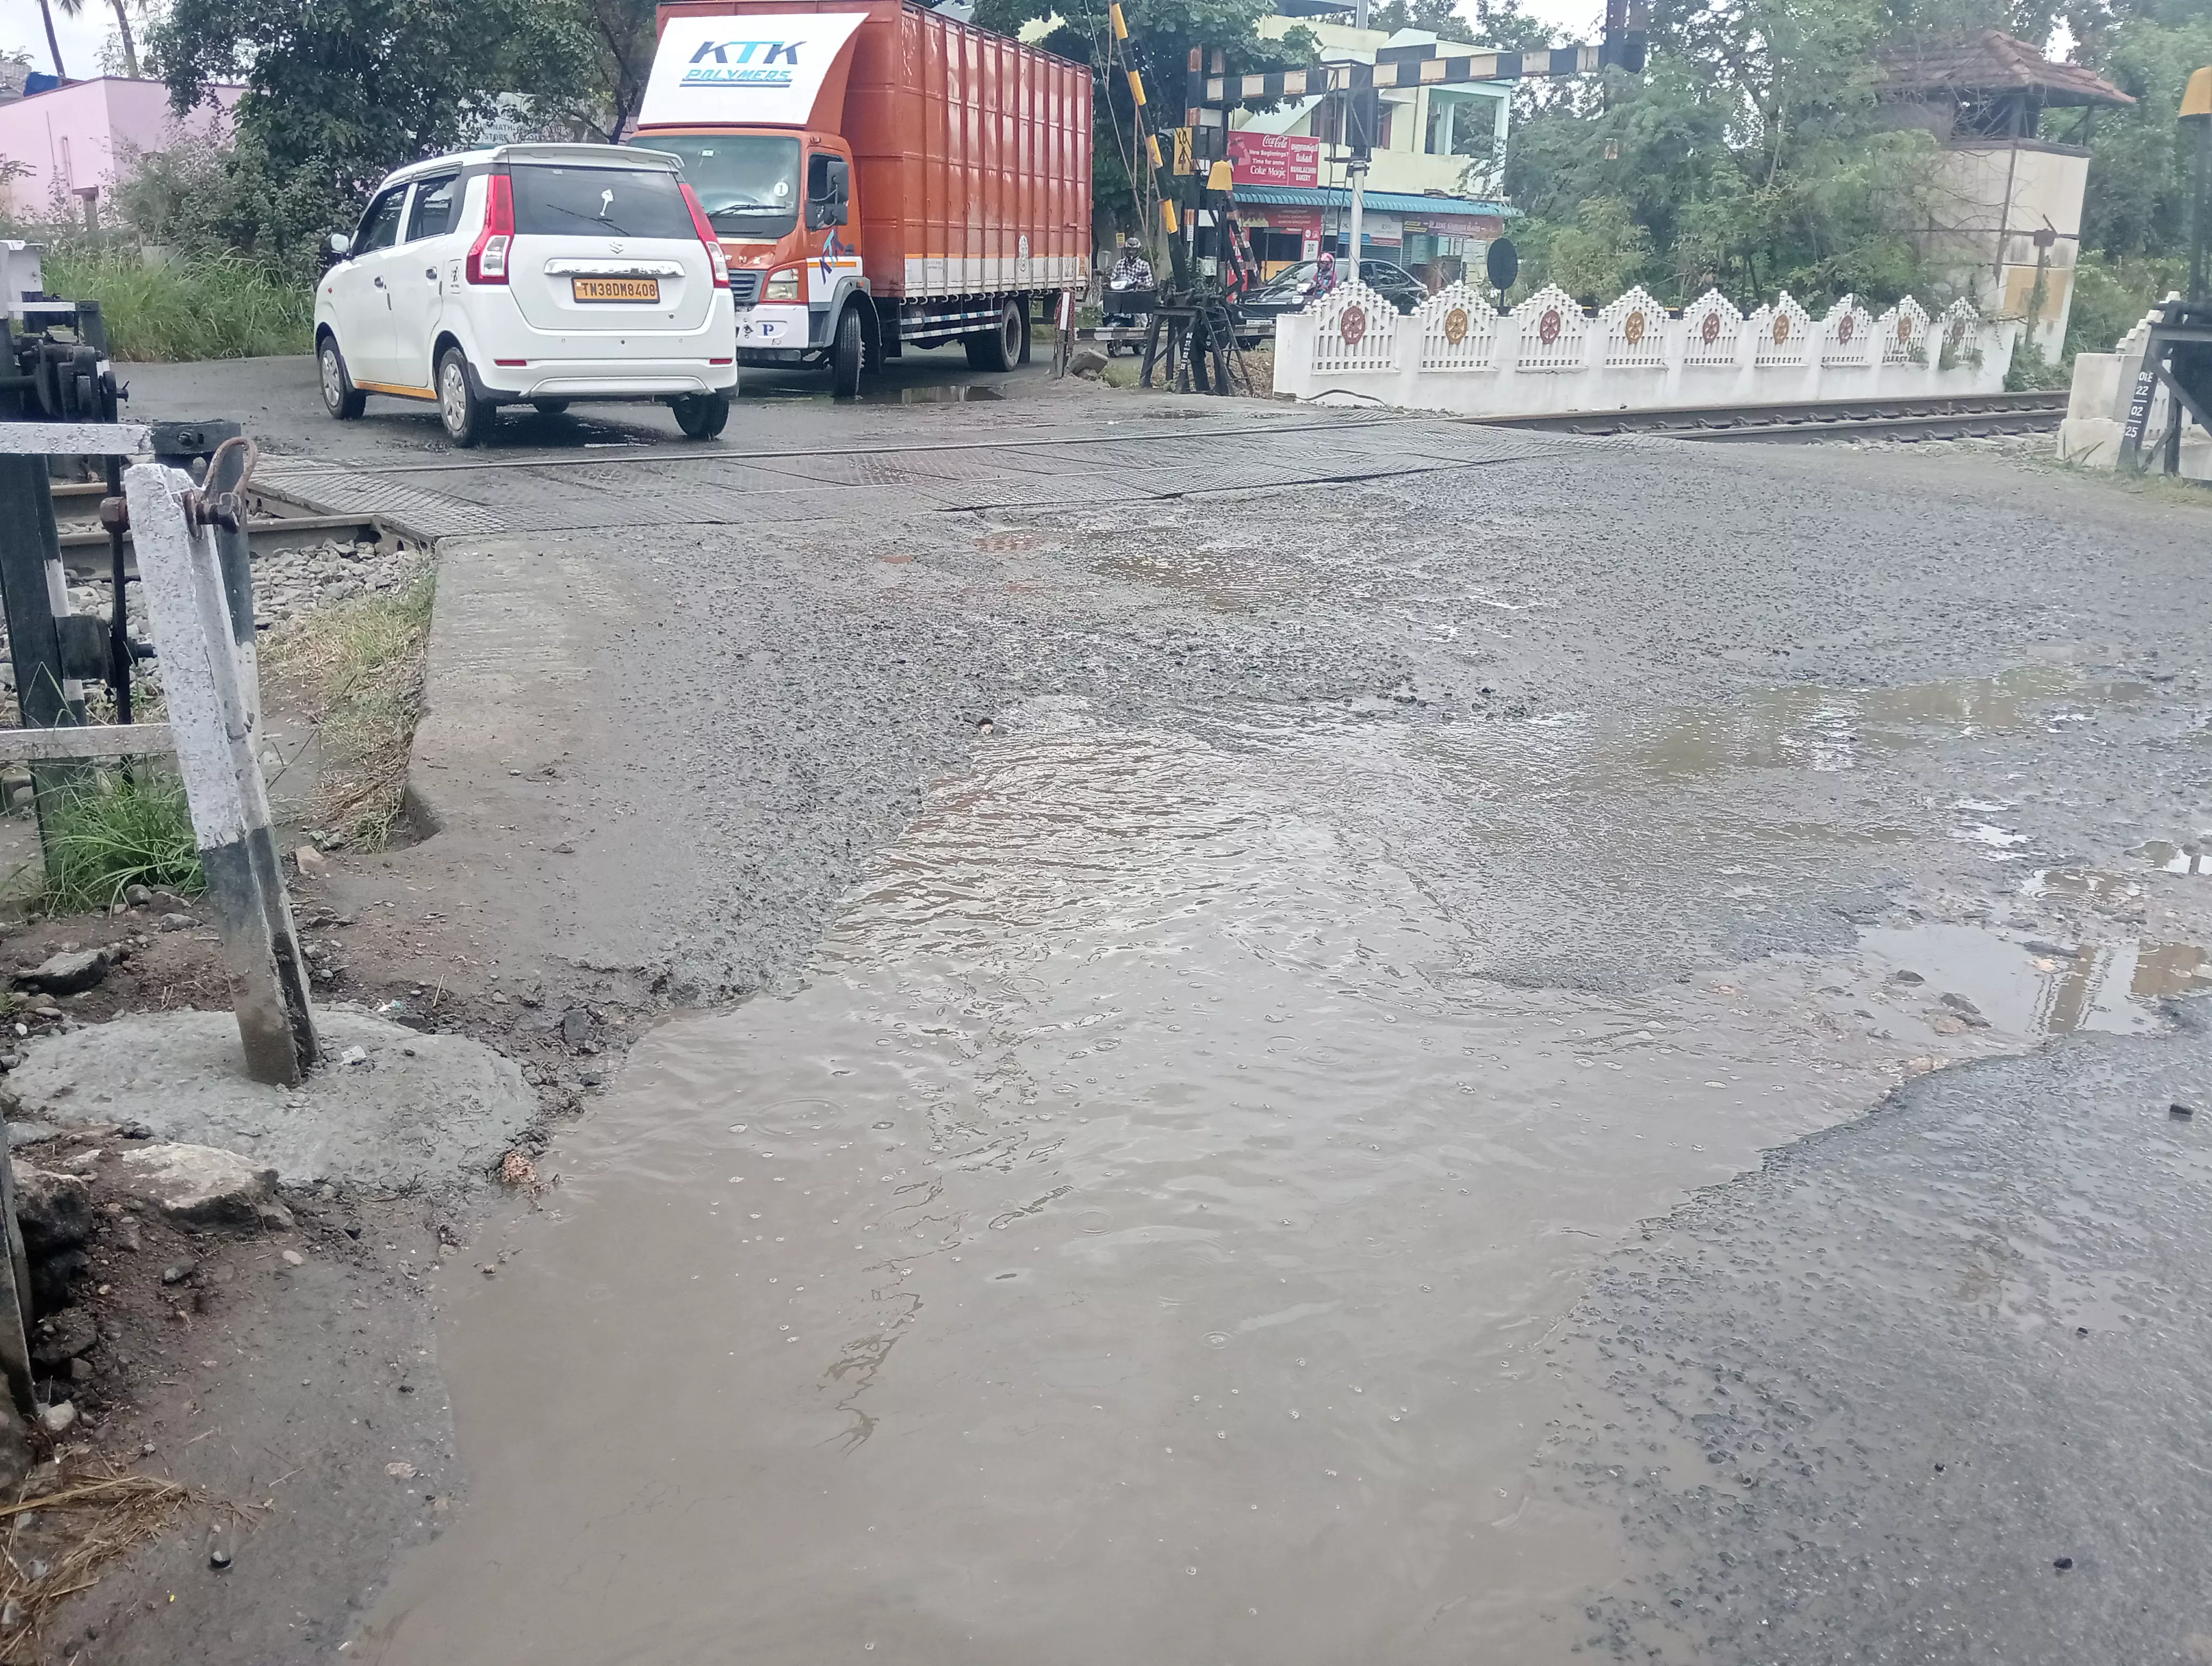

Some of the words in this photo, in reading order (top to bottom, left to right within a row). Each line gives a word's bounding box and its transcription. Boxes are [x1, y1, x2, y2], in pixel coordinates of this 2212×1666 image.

[689, 41, 807, 65] KTK
[685, 69, 792, 80] POLYMERS
[1250, 165, 1266, 175] Coke
[1268, 167, 1287, 178] Magic
[580, 282, 656, 297] TN38DM8408
[2136, 386, 2149, 395] 22
[2131, 406, 2144, 416] 02
[2125, 426, 2139, 438] 25
